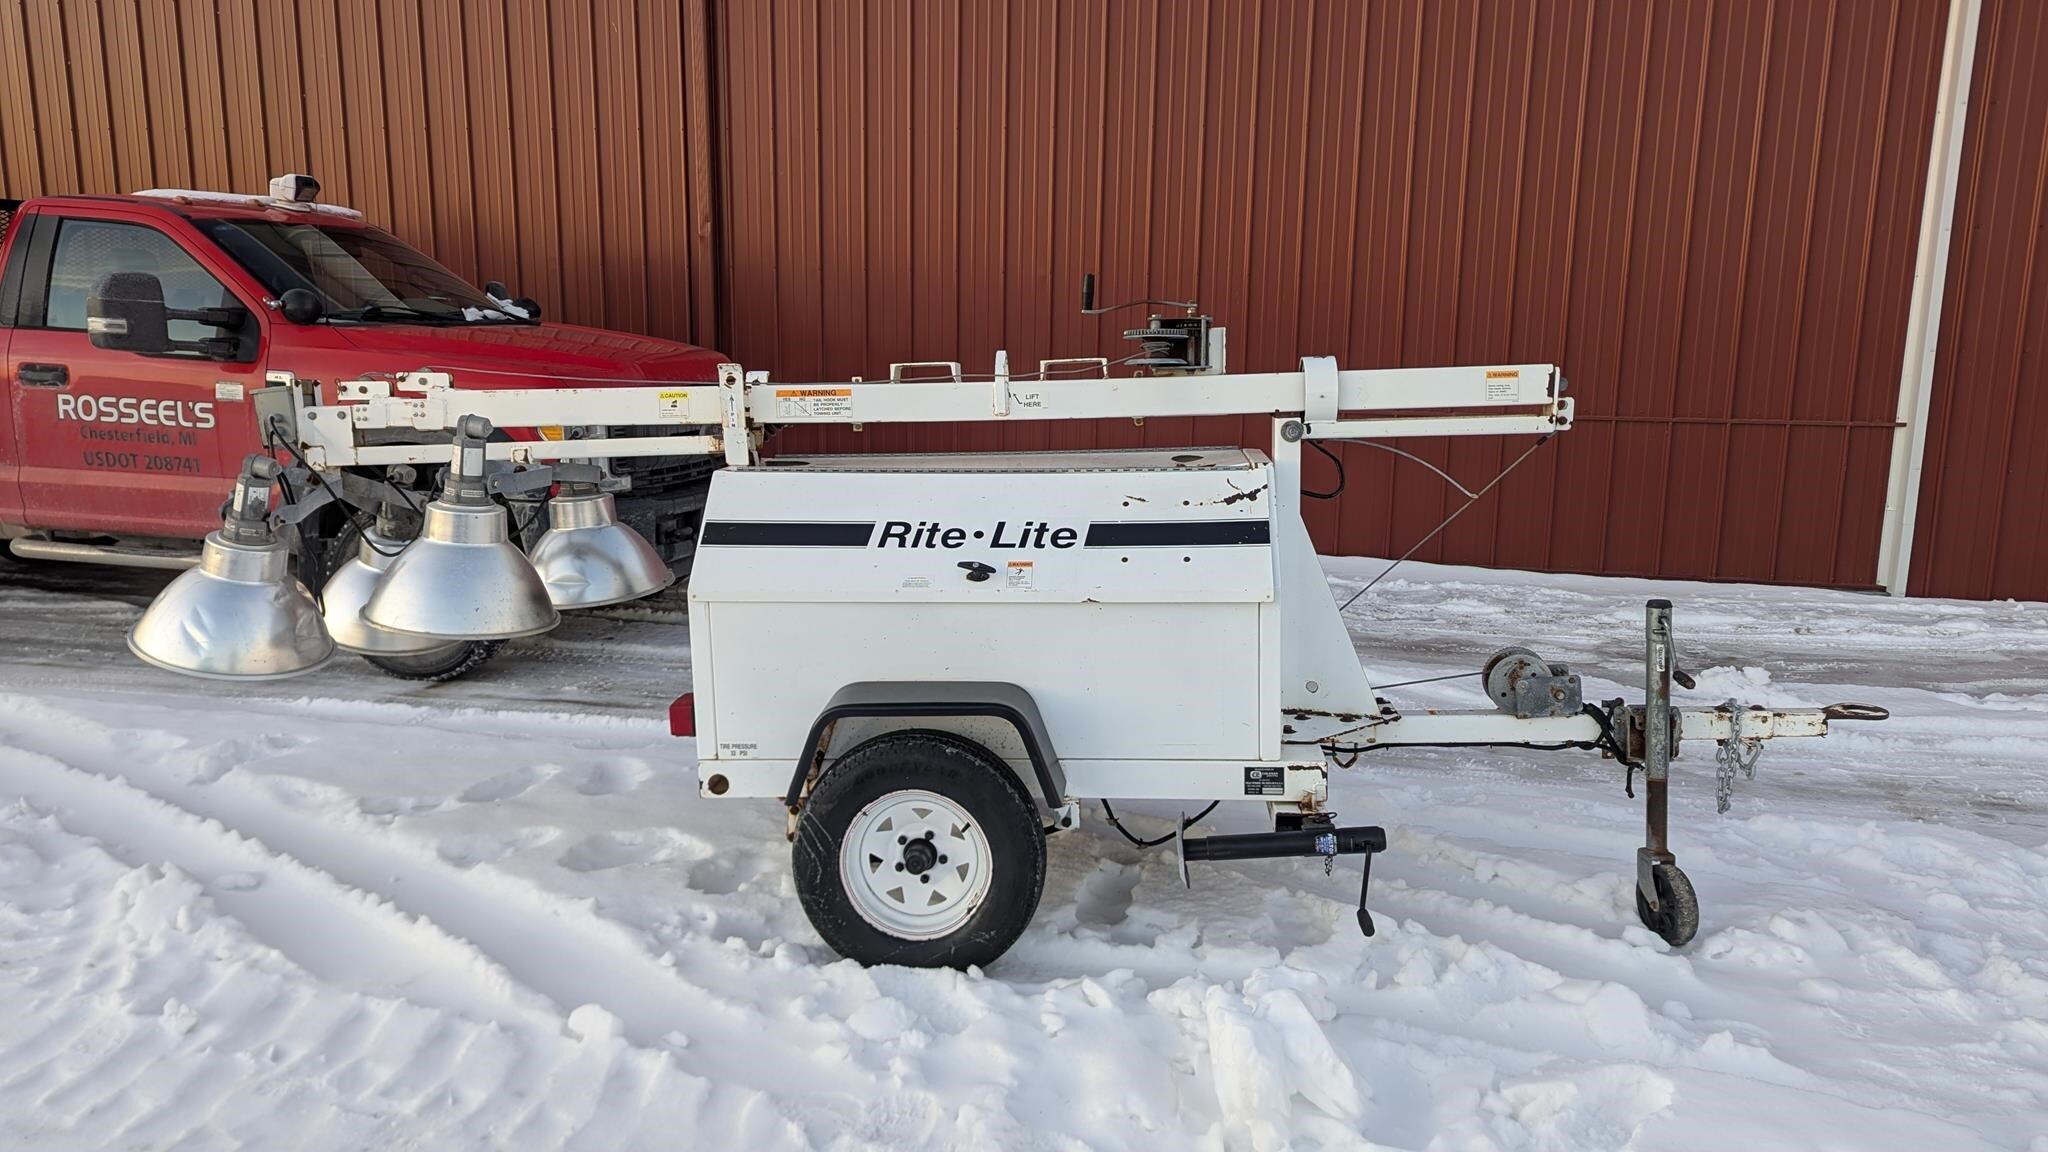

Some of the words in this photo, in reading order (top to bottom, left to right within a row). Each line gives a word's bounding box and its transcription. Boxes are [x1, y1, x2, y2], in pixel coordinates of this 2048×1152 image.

[57, 394, 215, 428] ROSSEEL'S
[80, 426, 175, 446] Chesterfield,
[179, 432, 197, 447] MI
[84, 451, 138, 468] USDOT
[145, 456, 201, 473] 208741
